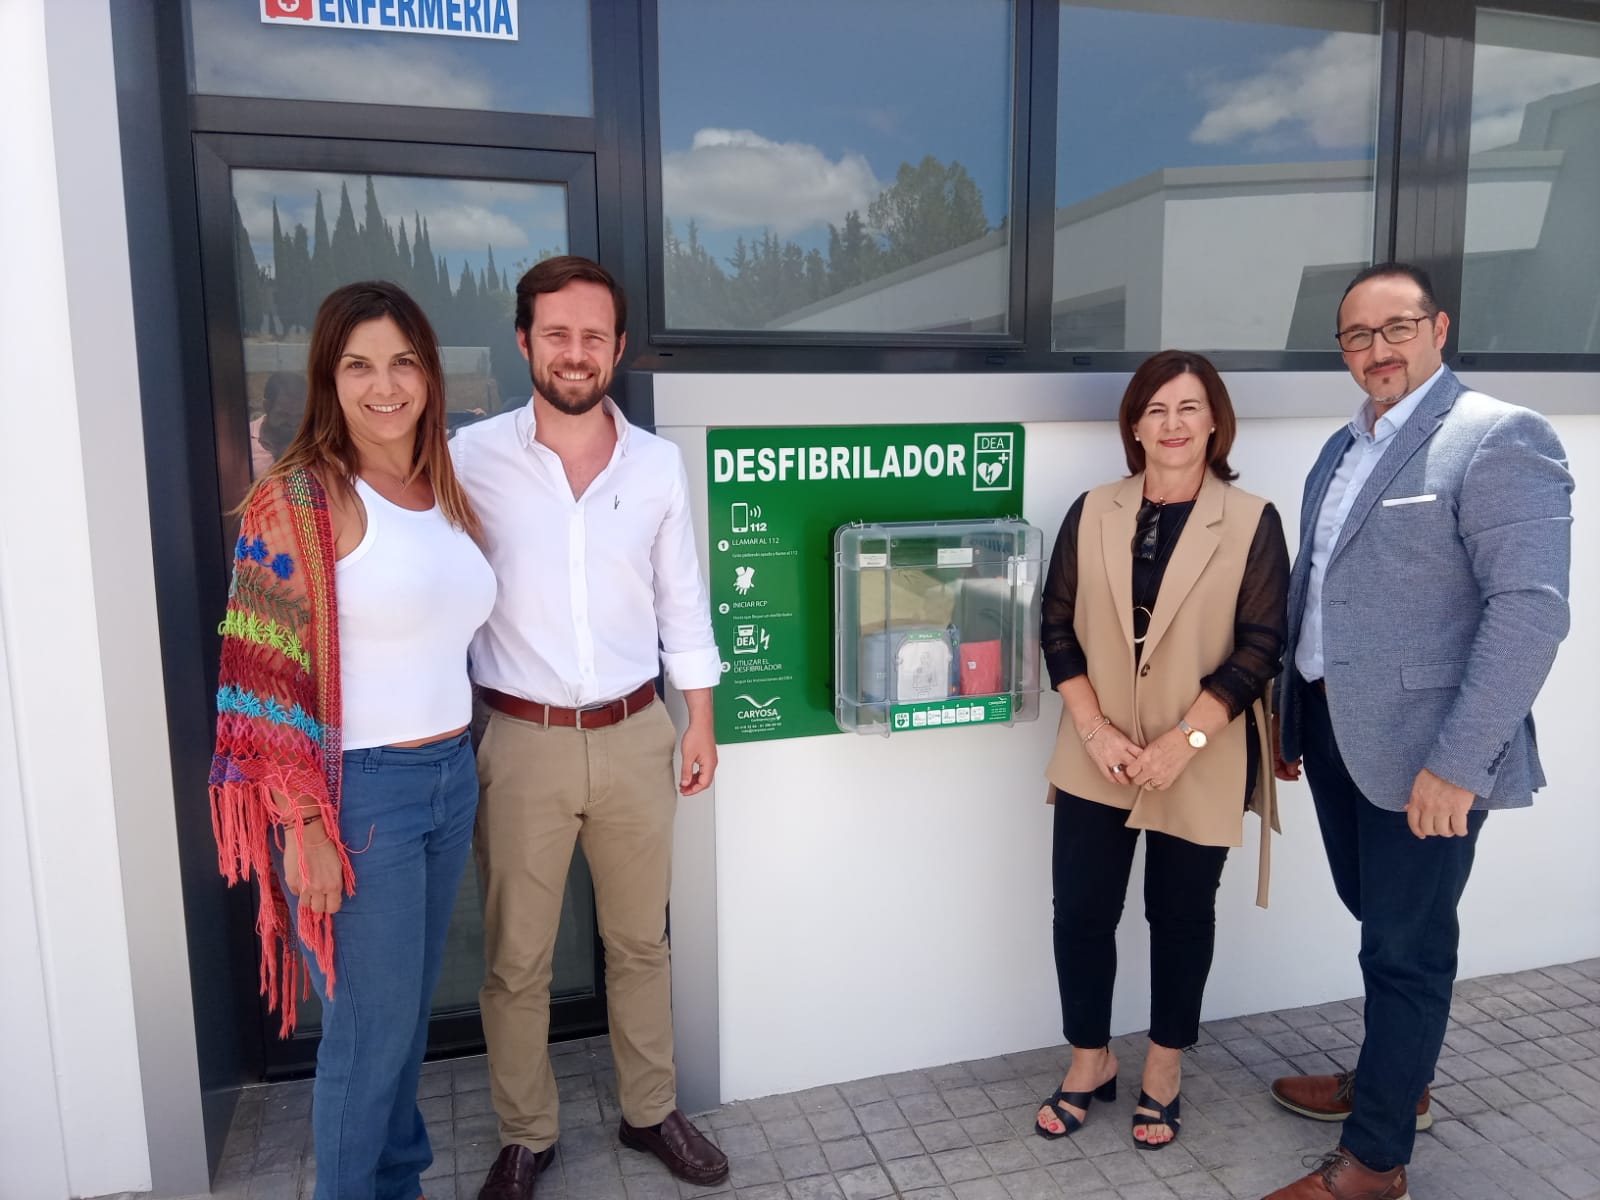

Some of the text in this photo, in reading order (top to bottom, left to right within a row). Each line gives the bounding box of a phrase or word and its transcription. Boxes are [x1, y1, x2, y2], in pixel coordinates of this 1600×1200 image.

[981, 437, 1004, 449] DEA
[714, 444, 966, 483] DESFIBRILADOR
[750, 522, 767, 532] 112
[732, 538, 758, 546] LLAMAR
[736, 637, 755, 647] DEA
[734, 659, 761, 667] UTILIZAR
[734, 664, 782, 673] DESFIBRILADOR
[737, 708, 778, 719] CARYOSA
